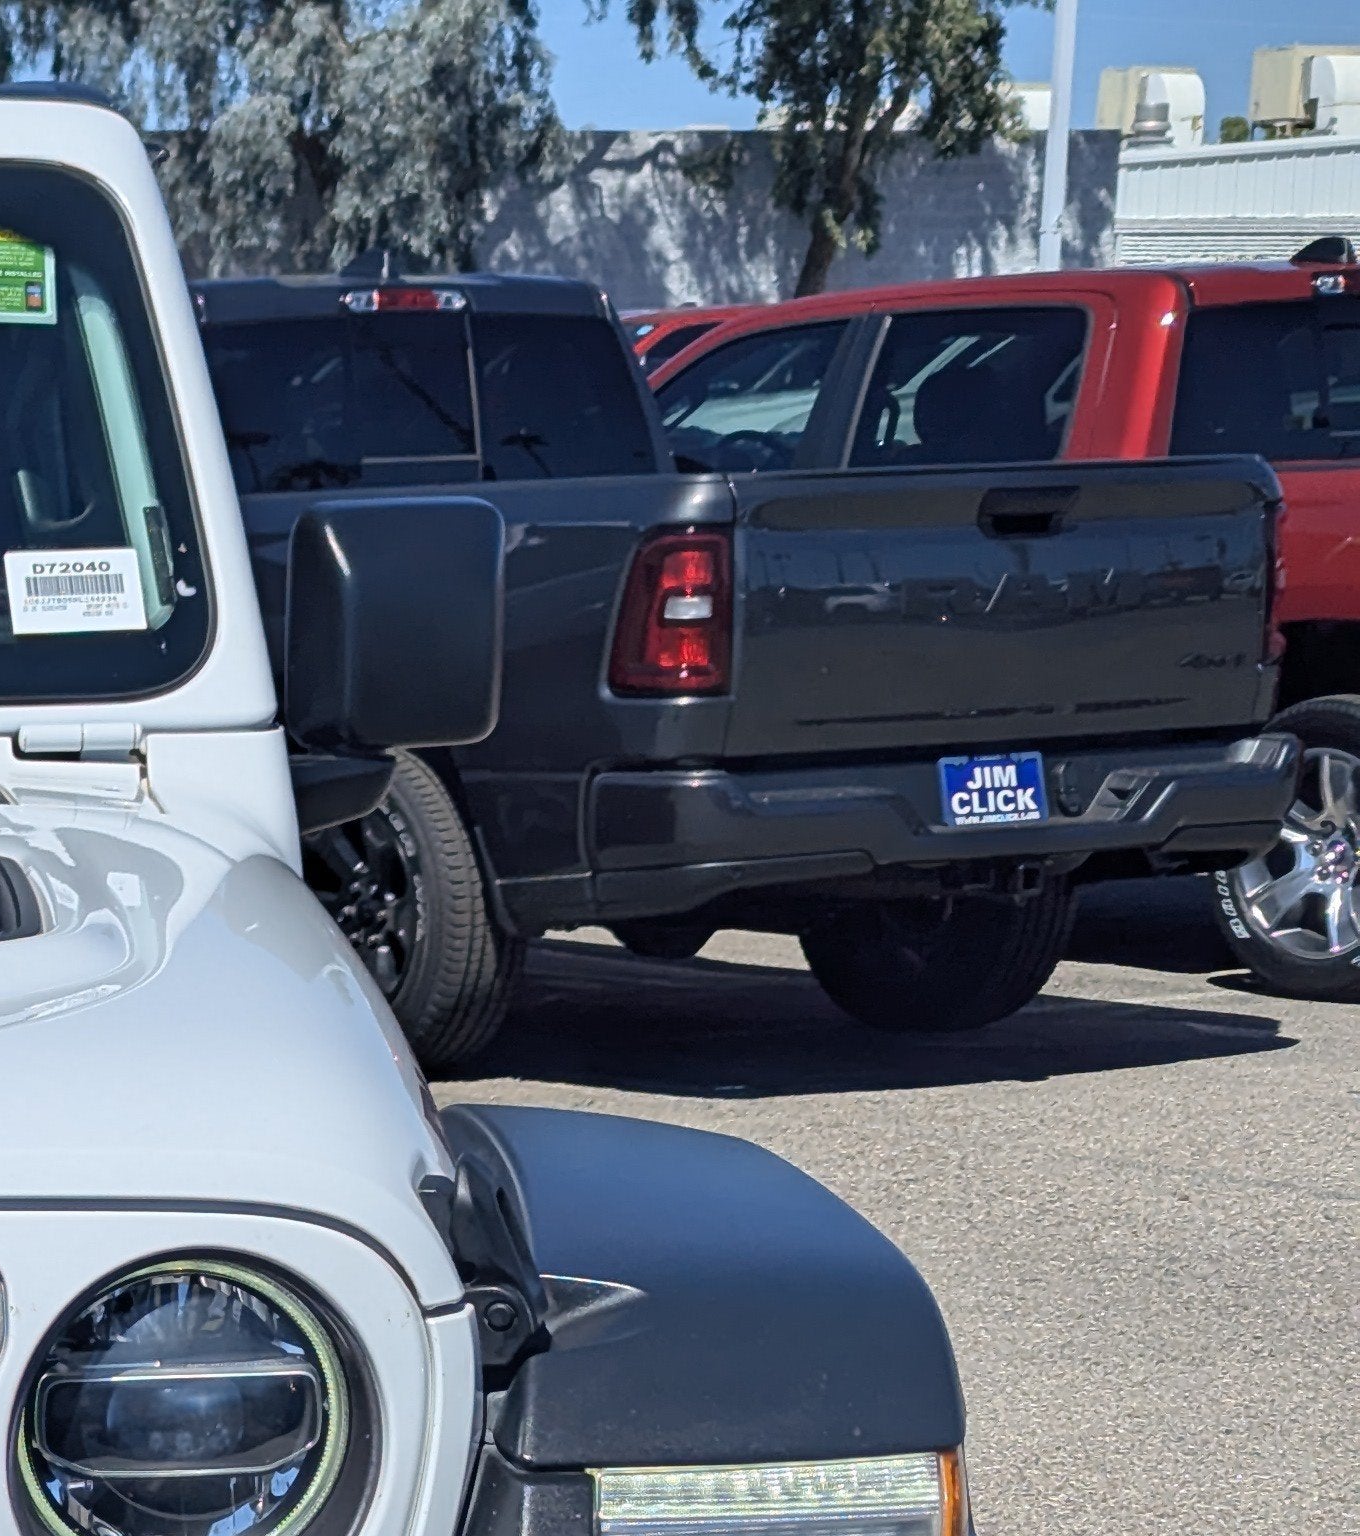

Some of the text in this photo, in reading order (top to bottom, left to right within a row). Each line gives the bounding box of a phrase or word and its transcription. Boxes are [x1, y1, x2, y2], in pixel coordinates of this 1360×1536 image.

[32, 561, 111, 575] D72040
[966, 764, 1018, 790] JIM
[951, 786, 1038, 815] CLICK
